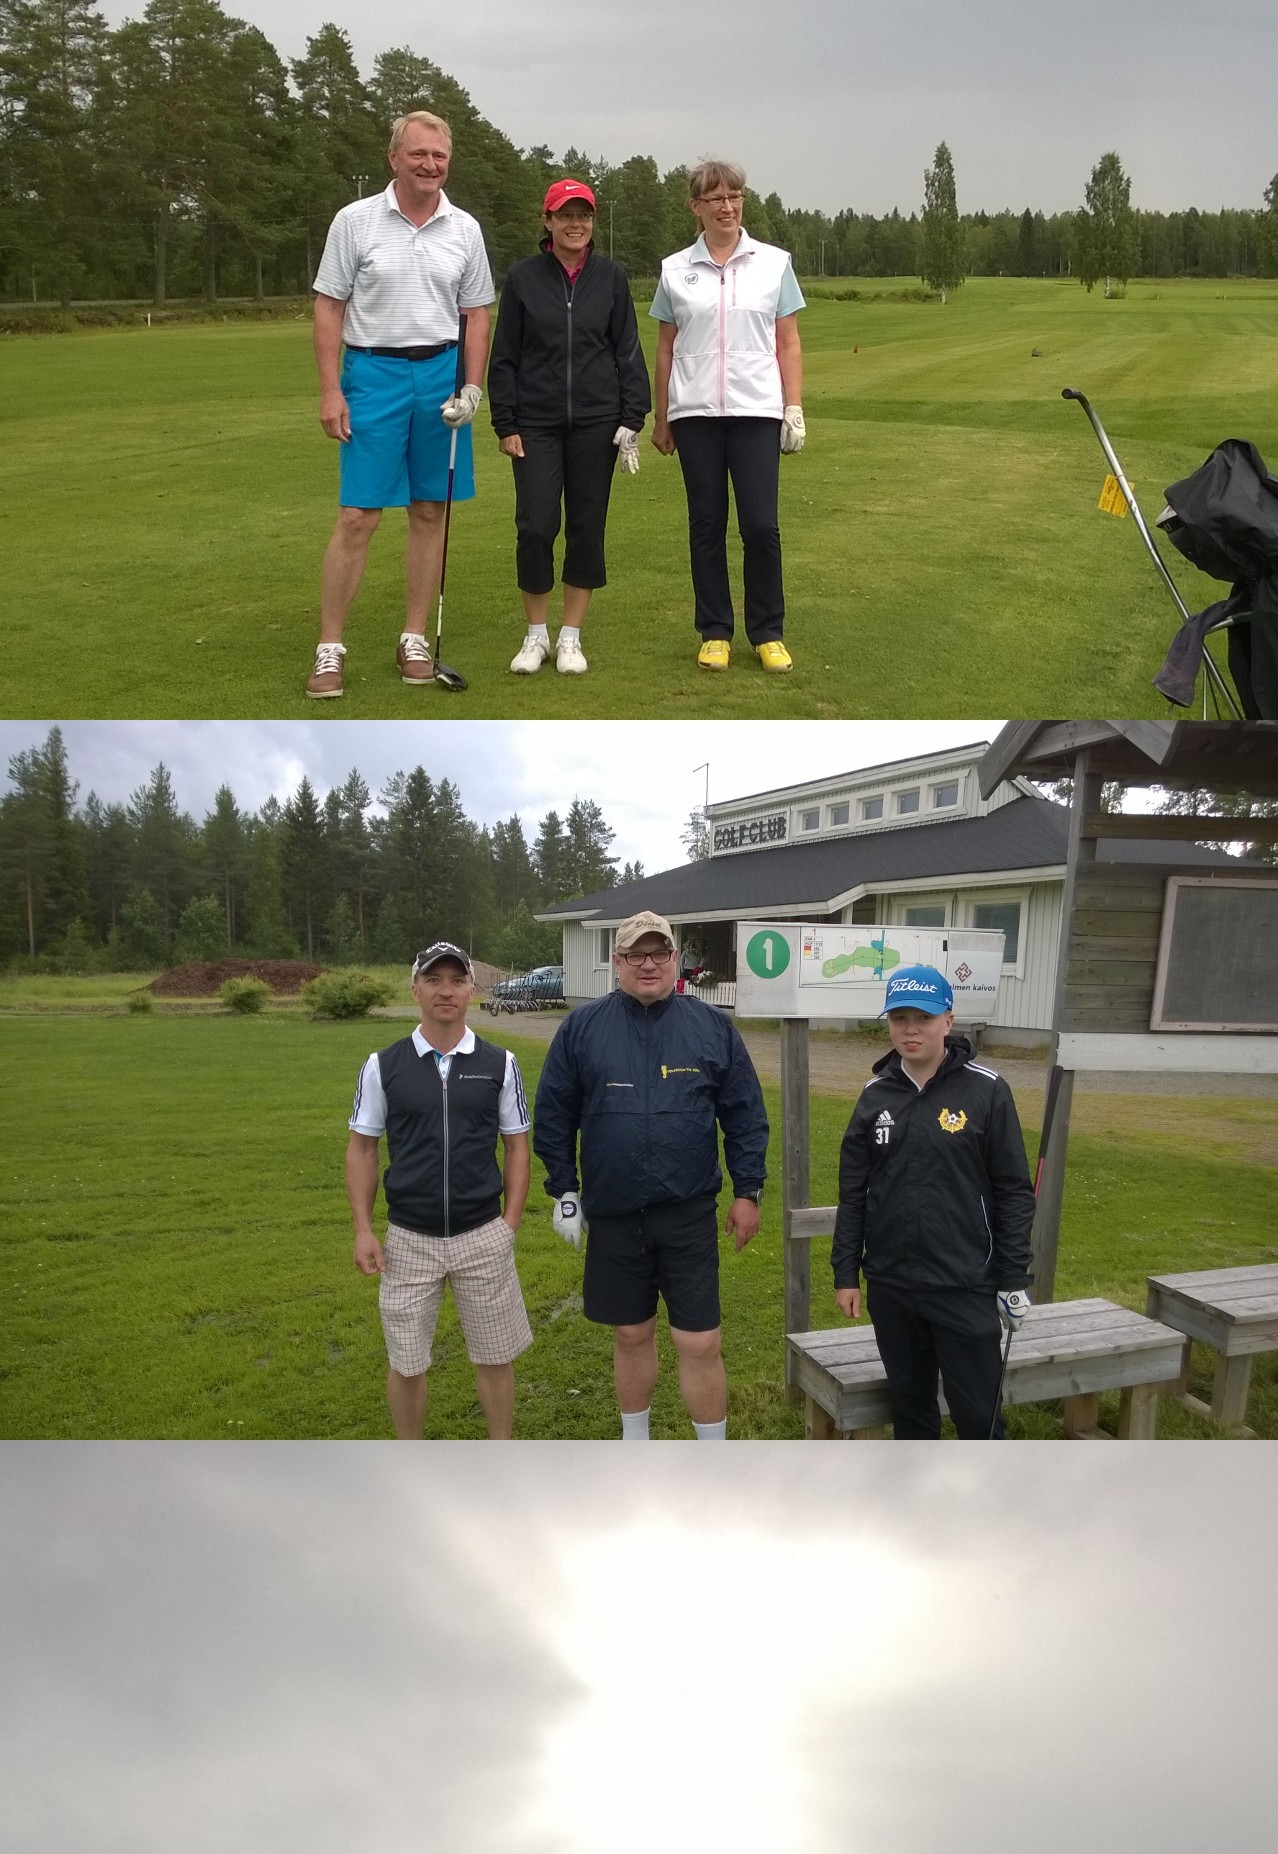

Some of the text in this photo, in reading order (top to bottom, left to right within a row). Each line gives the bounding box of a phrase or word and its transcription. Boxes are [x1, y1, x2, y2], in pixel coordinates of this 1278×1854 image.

[714, 816, 787, 849] GOLF CLUB
[763, 938, 773, 971] 1
[888, 978, 938, 996] Titleist
[973, 984, 996, 992] kaivos
[876, 1127, 890, 1144] 31
